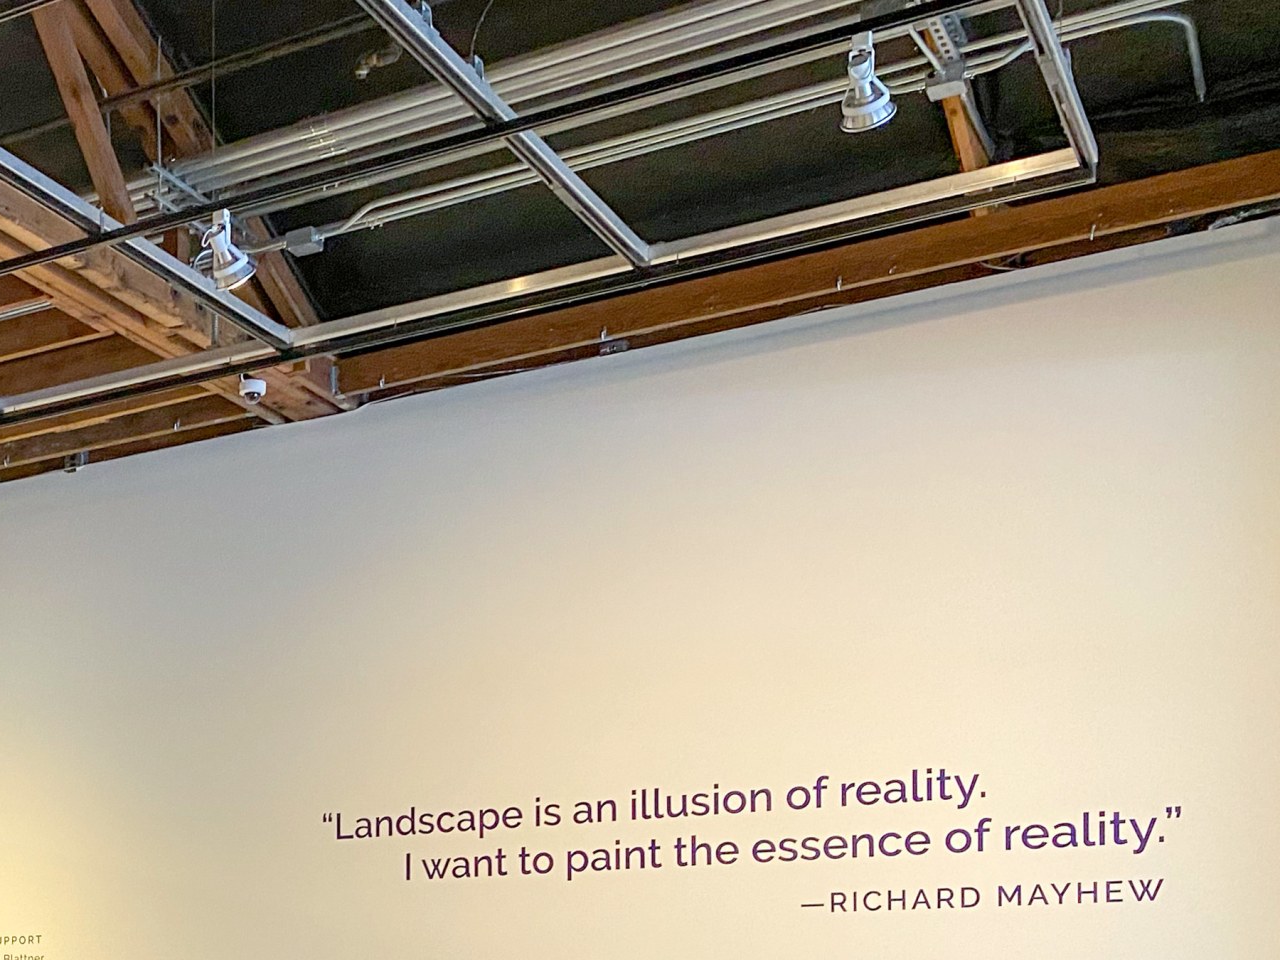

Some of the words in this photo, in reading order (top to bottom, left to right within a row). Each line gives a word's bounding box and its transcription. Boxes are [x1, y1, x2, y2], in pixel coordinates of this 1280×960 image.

[322, 806, 524, 841] “Landscape
[535, 796, 562, 828] is
[572, 799, 617, 825] an
[631, 783, 772, 821] illusion
[786, 775, 830, 811] of
[840, 767, 986, 810] reality.
[405, 852, 412, 881] I
[420, 847, 508, 880] want
[517, 846, 555, 876] to
[566, 836, 663, 882] paint
[673, 834, 740, 868] the
[751, 829, 931, 864] essence
[944, 817, 993, 854] of
[1004, 805, 1182, 855] reality.”
[997, 878, 1165, 907] MAYHEW
